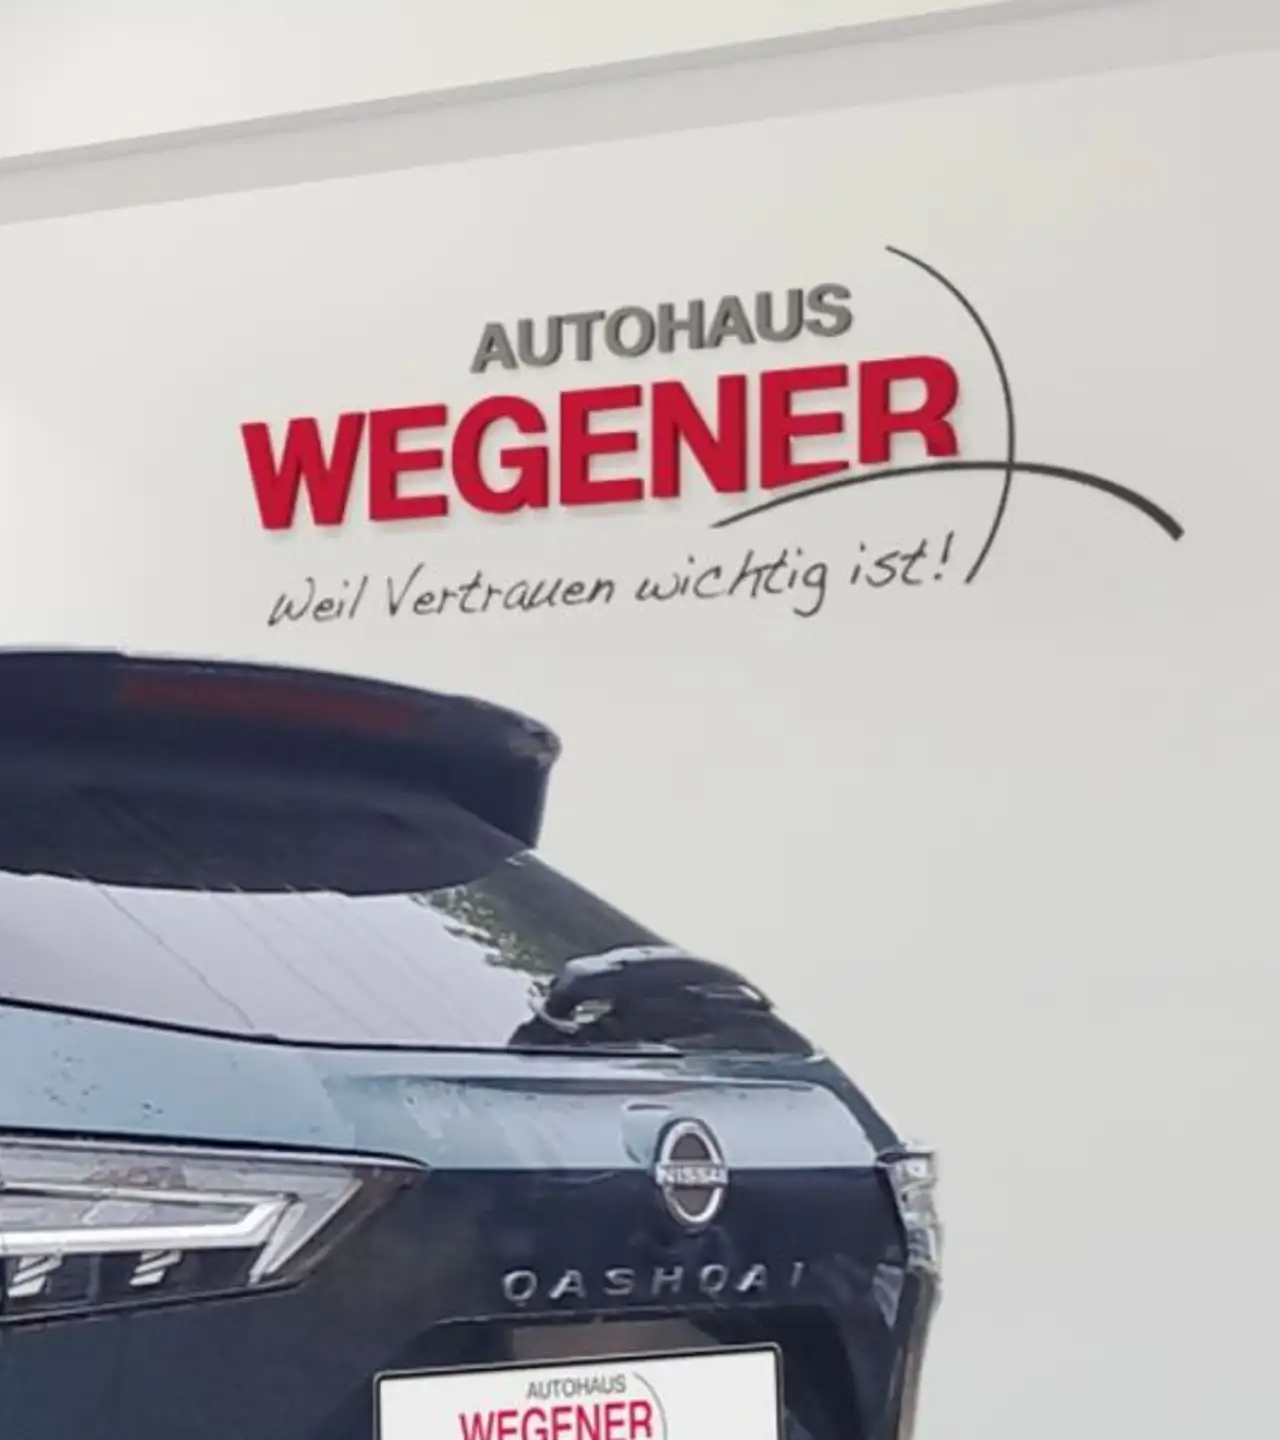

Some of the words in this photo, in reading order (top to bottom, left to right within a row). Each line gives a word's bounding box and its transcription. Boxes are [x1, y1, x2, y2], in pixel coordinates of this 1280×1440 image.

[470, 283, 853, 373] AUTOHAUS
[241, 354, 960, 531] WEGENER
[267, 577, 369, 628] Weil
[384, 562, 616, 622] Vertrauen
[633, 538, 830, 619] wichtig
[849, 532, 955, 588] ist!
[503, 1261, 805, 1305] QASHQAI
[526, 1374, 627, 1399] AUTOHAUS
